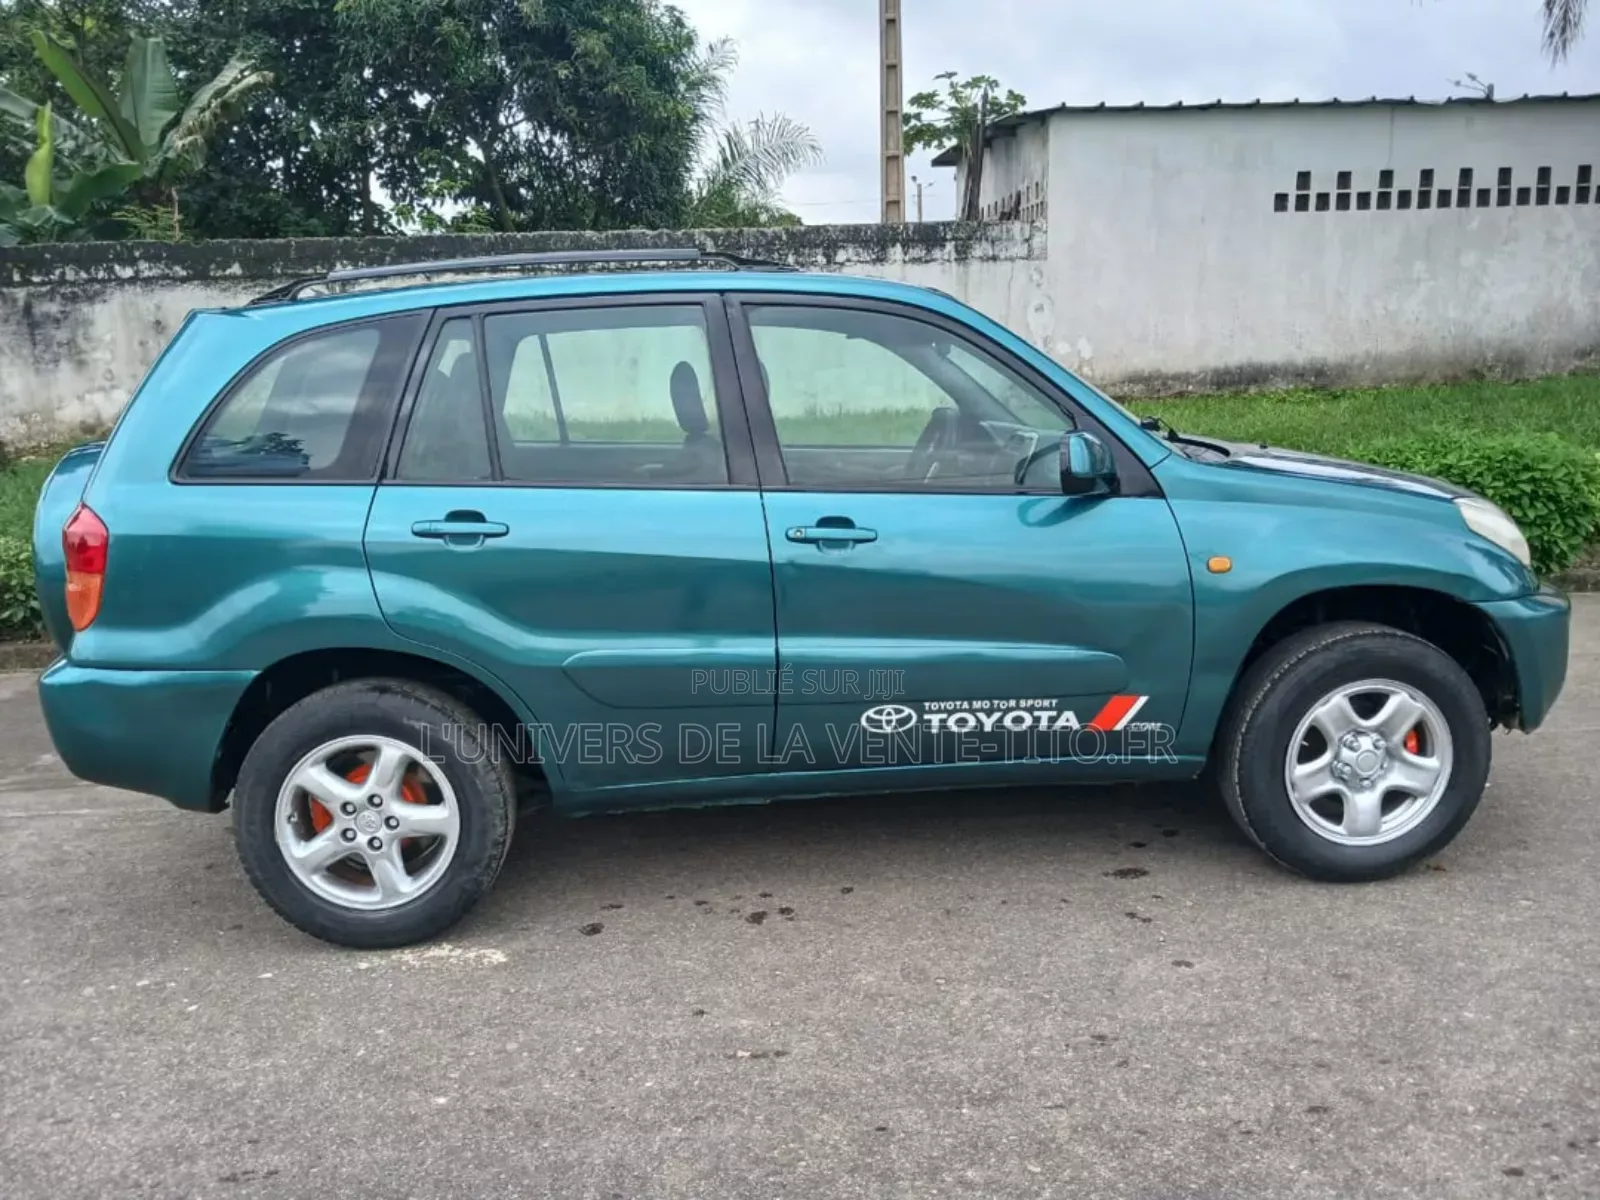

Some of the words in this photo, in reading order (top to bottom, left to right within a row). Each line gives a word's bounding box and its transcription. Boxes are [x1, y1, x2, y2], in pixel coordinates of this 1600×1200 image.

[923, 701, 970, 711] TOYOTA
[1019, 698, 1058, 708] SPORT
[922, 710, 1081, 734] TOYOTA
